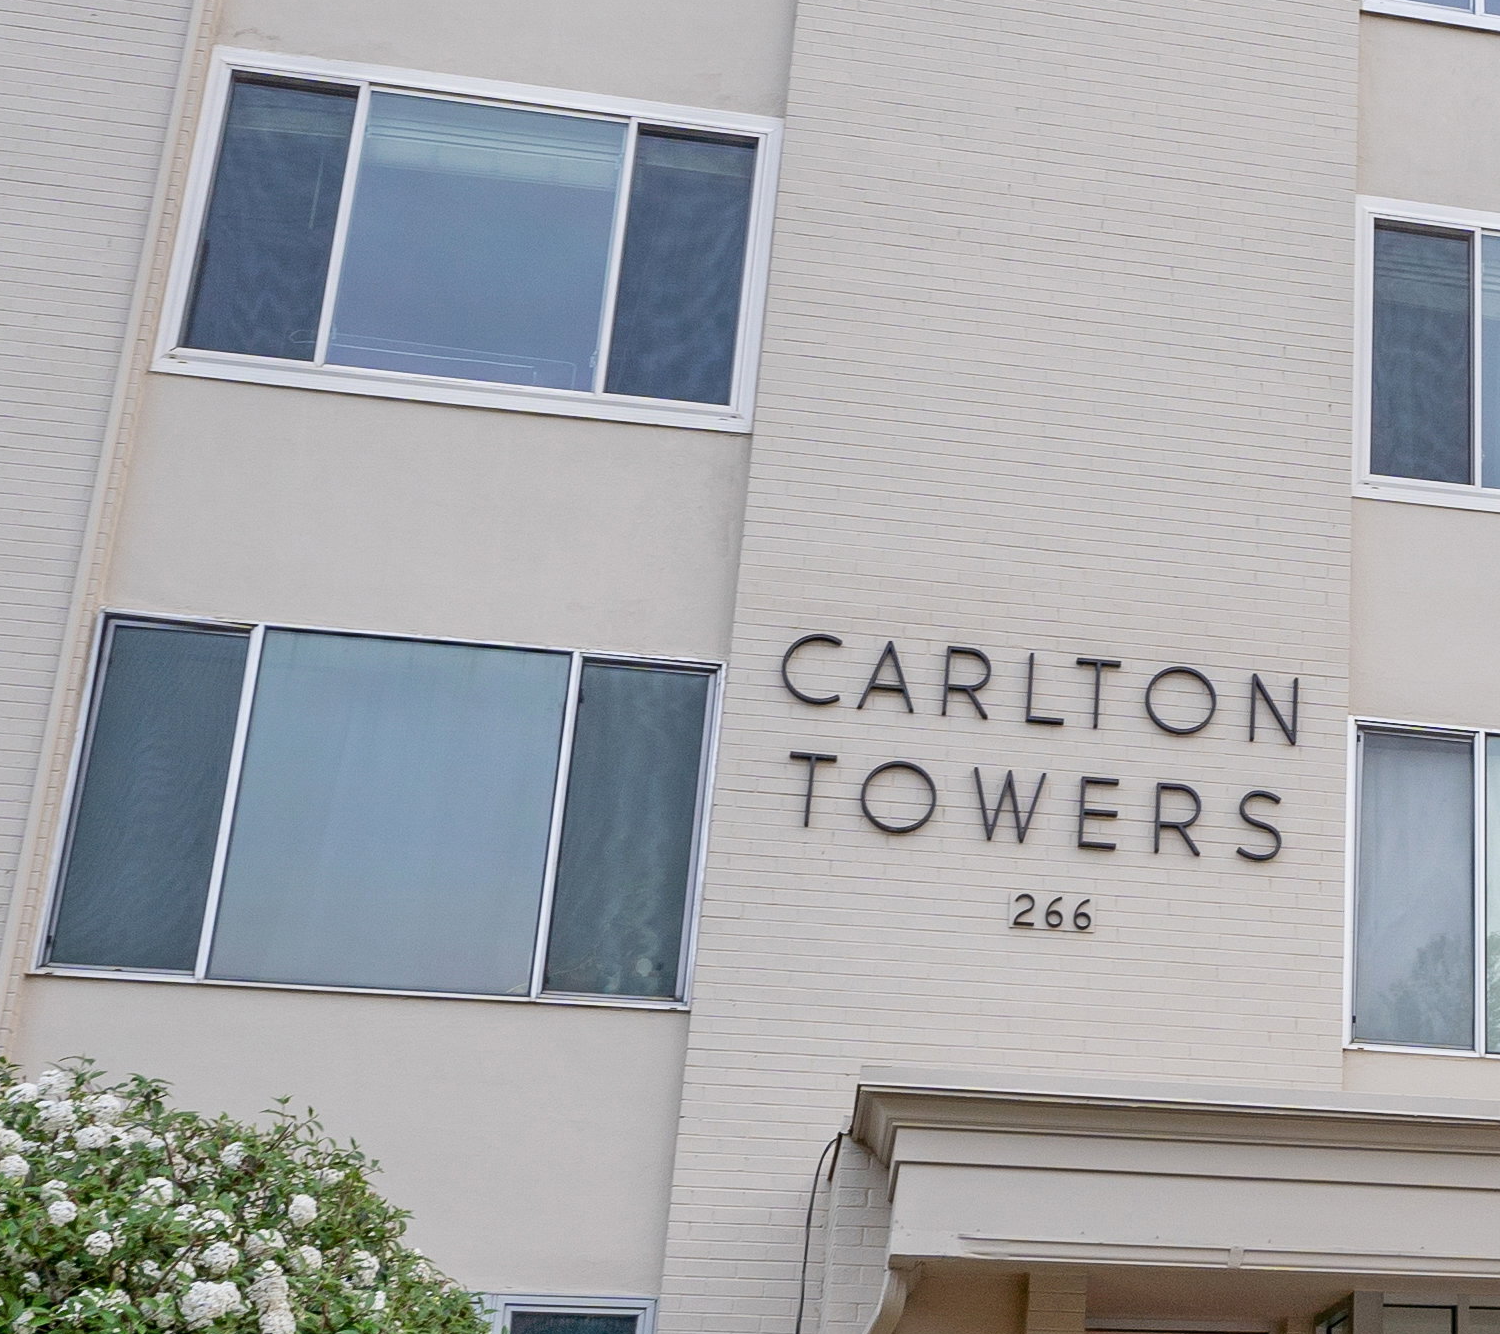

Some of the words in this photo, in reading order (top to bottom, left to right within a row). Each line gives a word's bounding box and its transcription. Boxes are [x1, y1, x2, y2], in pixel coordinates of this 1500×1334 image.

[782, 633, 1299, 746] CARLTON
[789, 751, 1283, 861] TOWERS
[1012, 893, 1092, 931] 266
